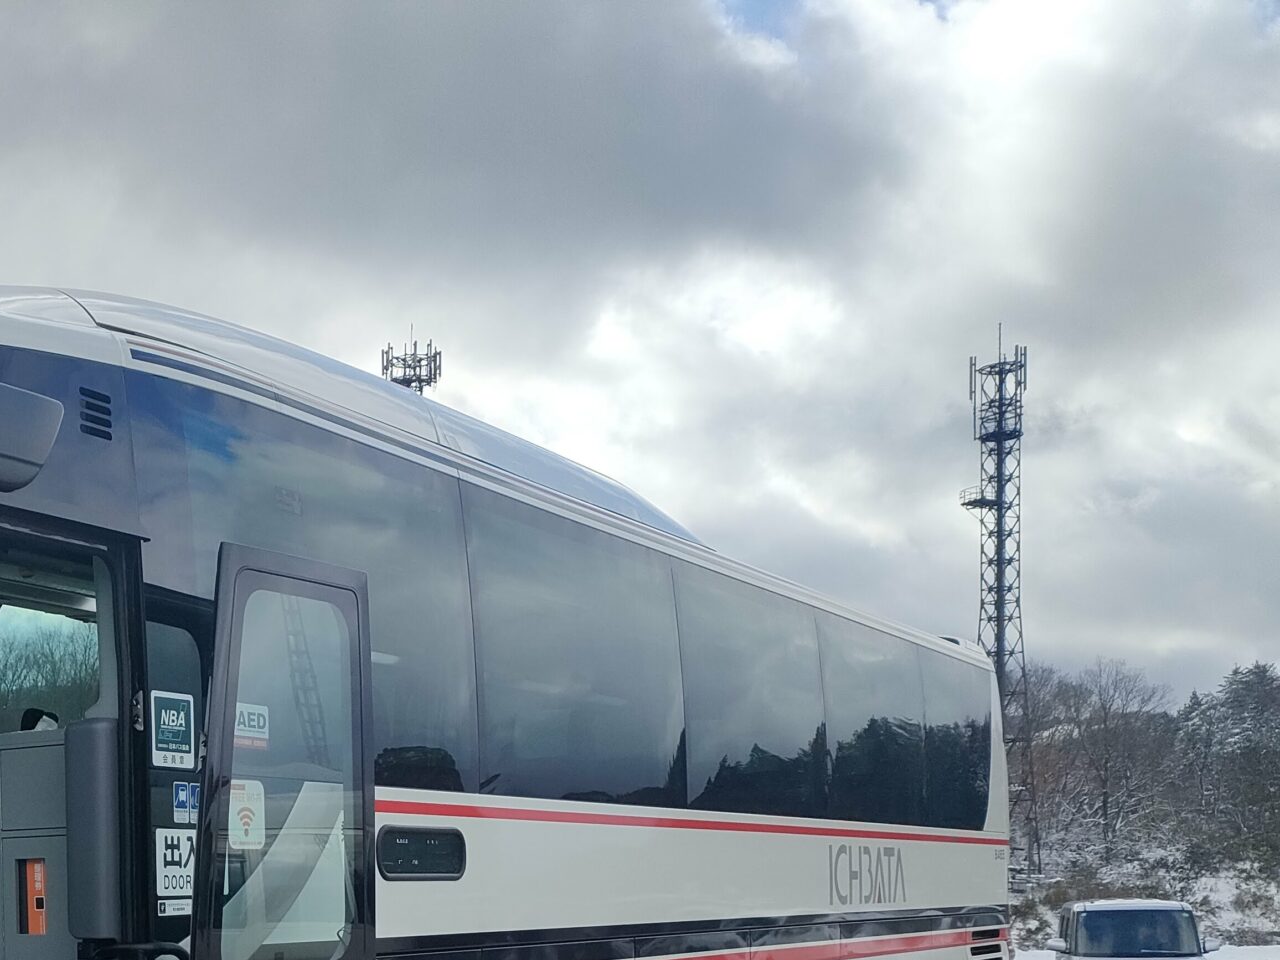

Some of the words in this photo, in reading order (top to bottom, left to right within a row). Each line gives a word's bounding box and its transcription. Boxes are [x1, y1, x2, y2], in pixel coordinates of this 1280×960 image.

[160, 709, 186, 727] NBA
[237, 710, 267, 730] AED
[163, 875, 192, 890] DOOR
